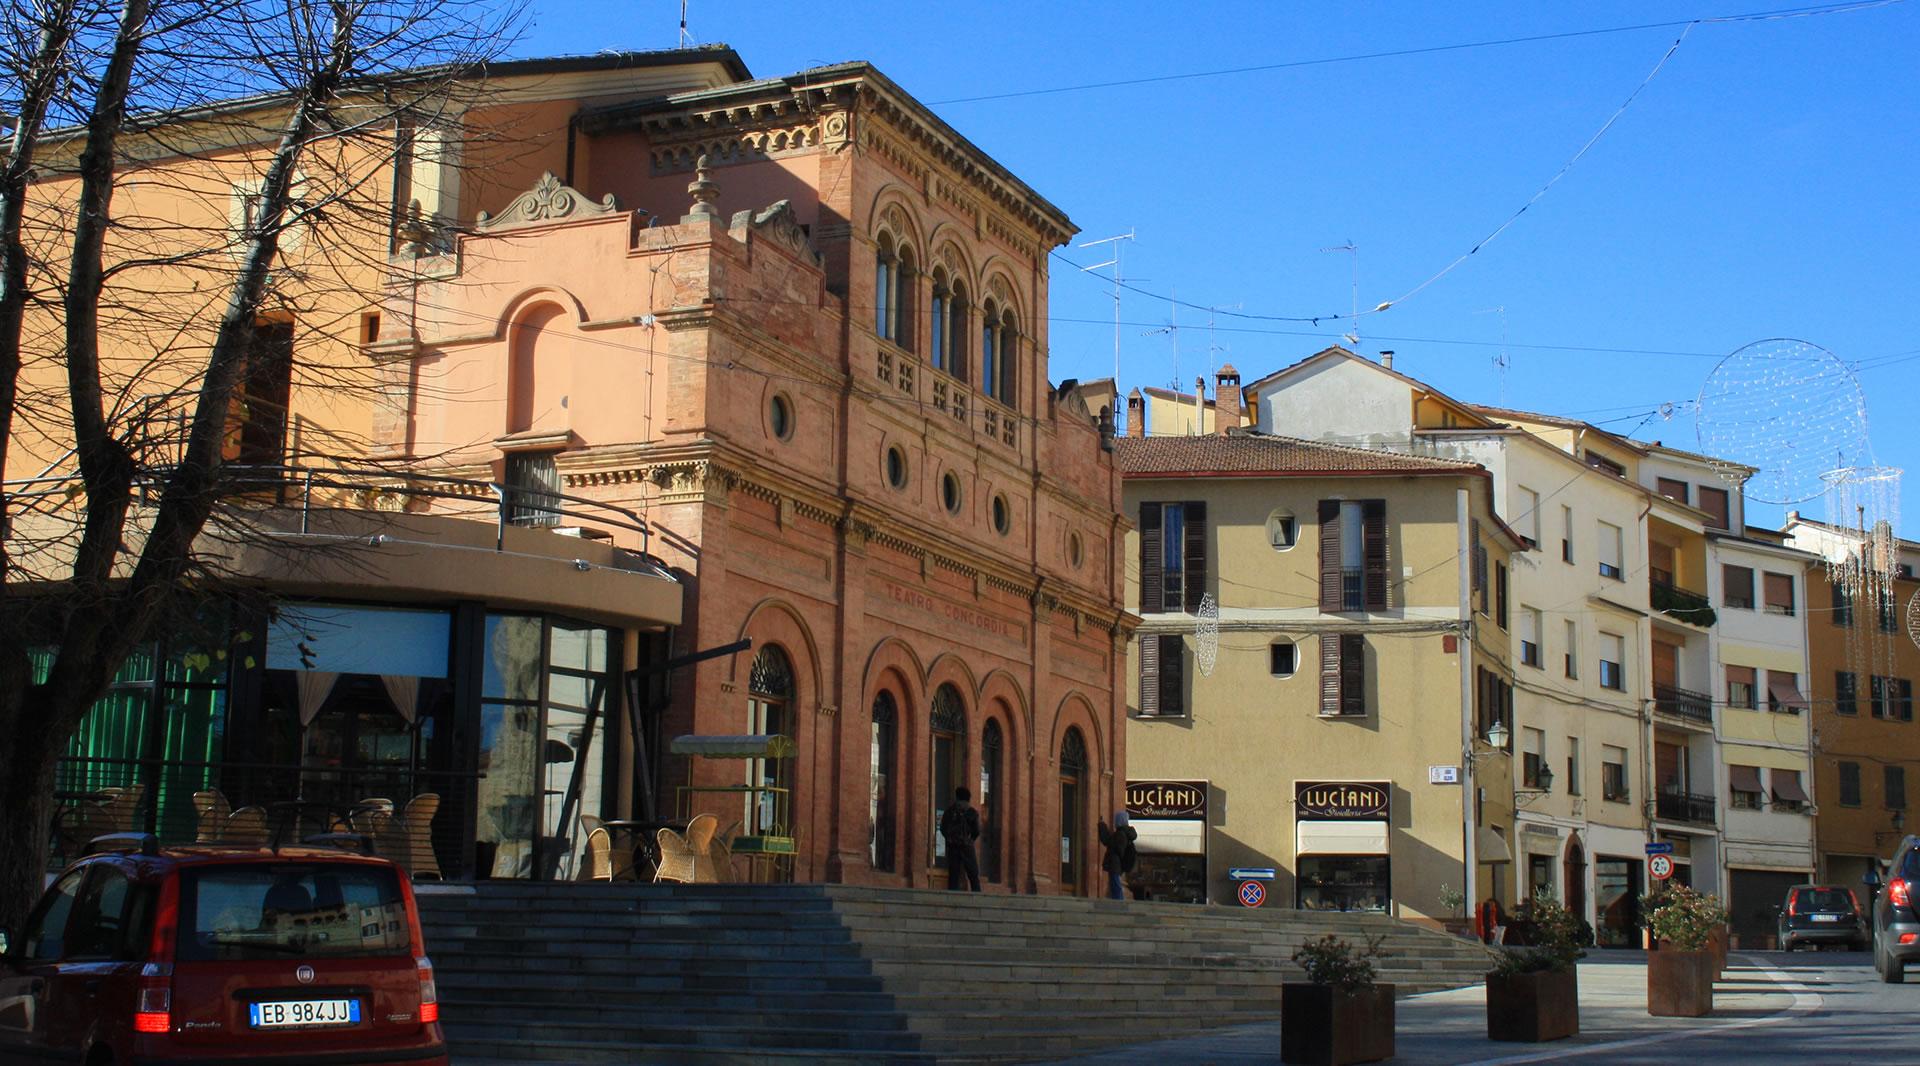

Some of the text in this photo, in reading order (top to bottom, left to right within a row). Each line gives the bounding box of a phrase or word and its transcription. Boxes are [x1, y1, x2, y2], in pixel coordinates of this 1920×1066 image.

[886, 584, 1008, 636] TEATRO CONCORDIA
[1126, 786, 1196, 806] LUCIANI
[1307, 787, 1379, 807] LUCIANI
[263, 1004, 285, 1023] EB
[292, 1002, 348, 1021] 984JJ
